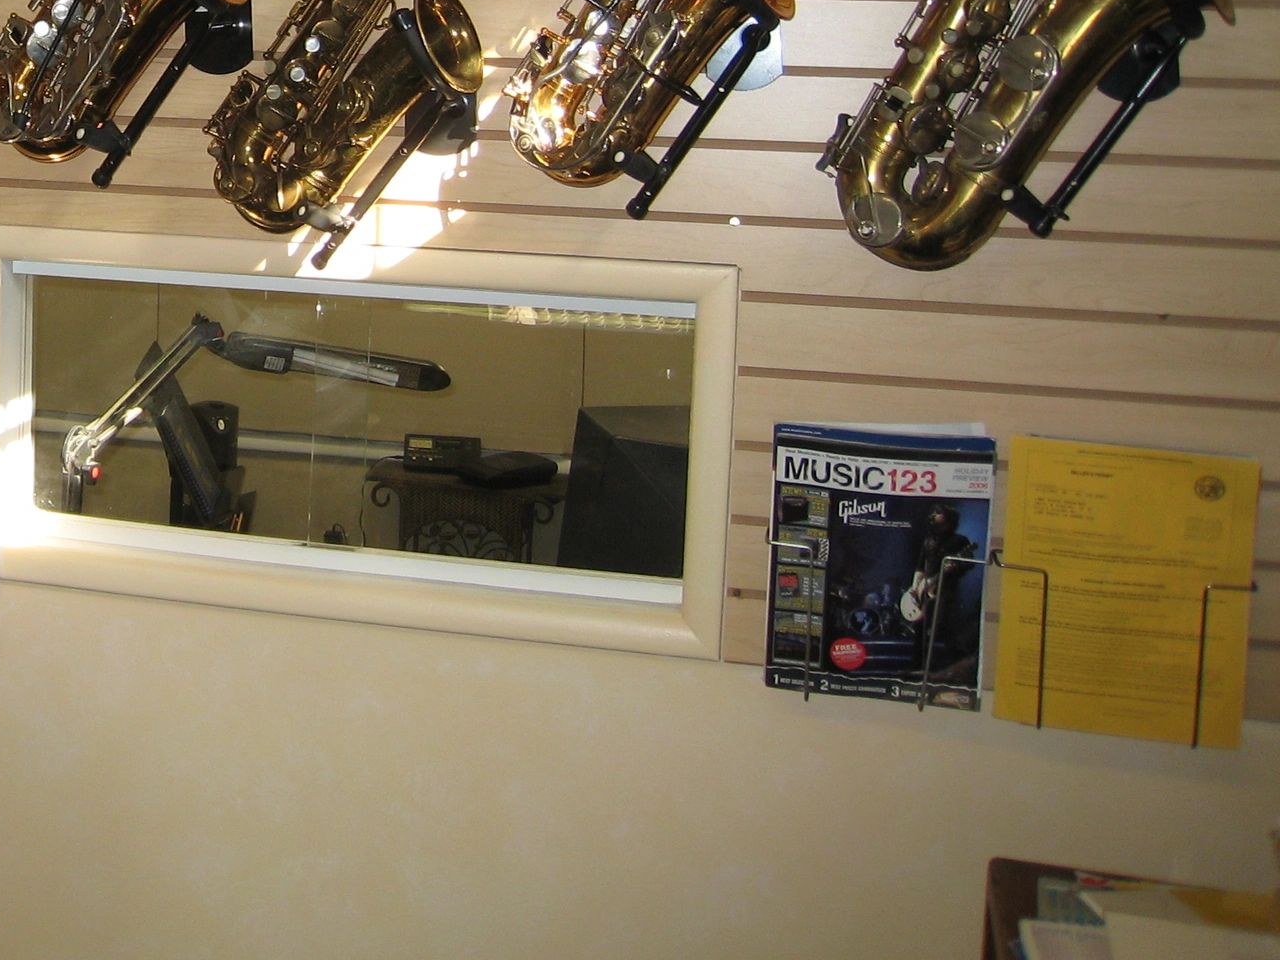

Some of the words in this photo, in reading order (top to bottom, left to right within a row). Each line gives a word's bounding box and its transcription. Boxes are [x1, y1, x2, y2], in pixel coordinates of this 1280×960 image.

[838, 499, 887, 524] Gibson
[820, 680, 829, 691] 2
[891, 685, 900, 697] 3
